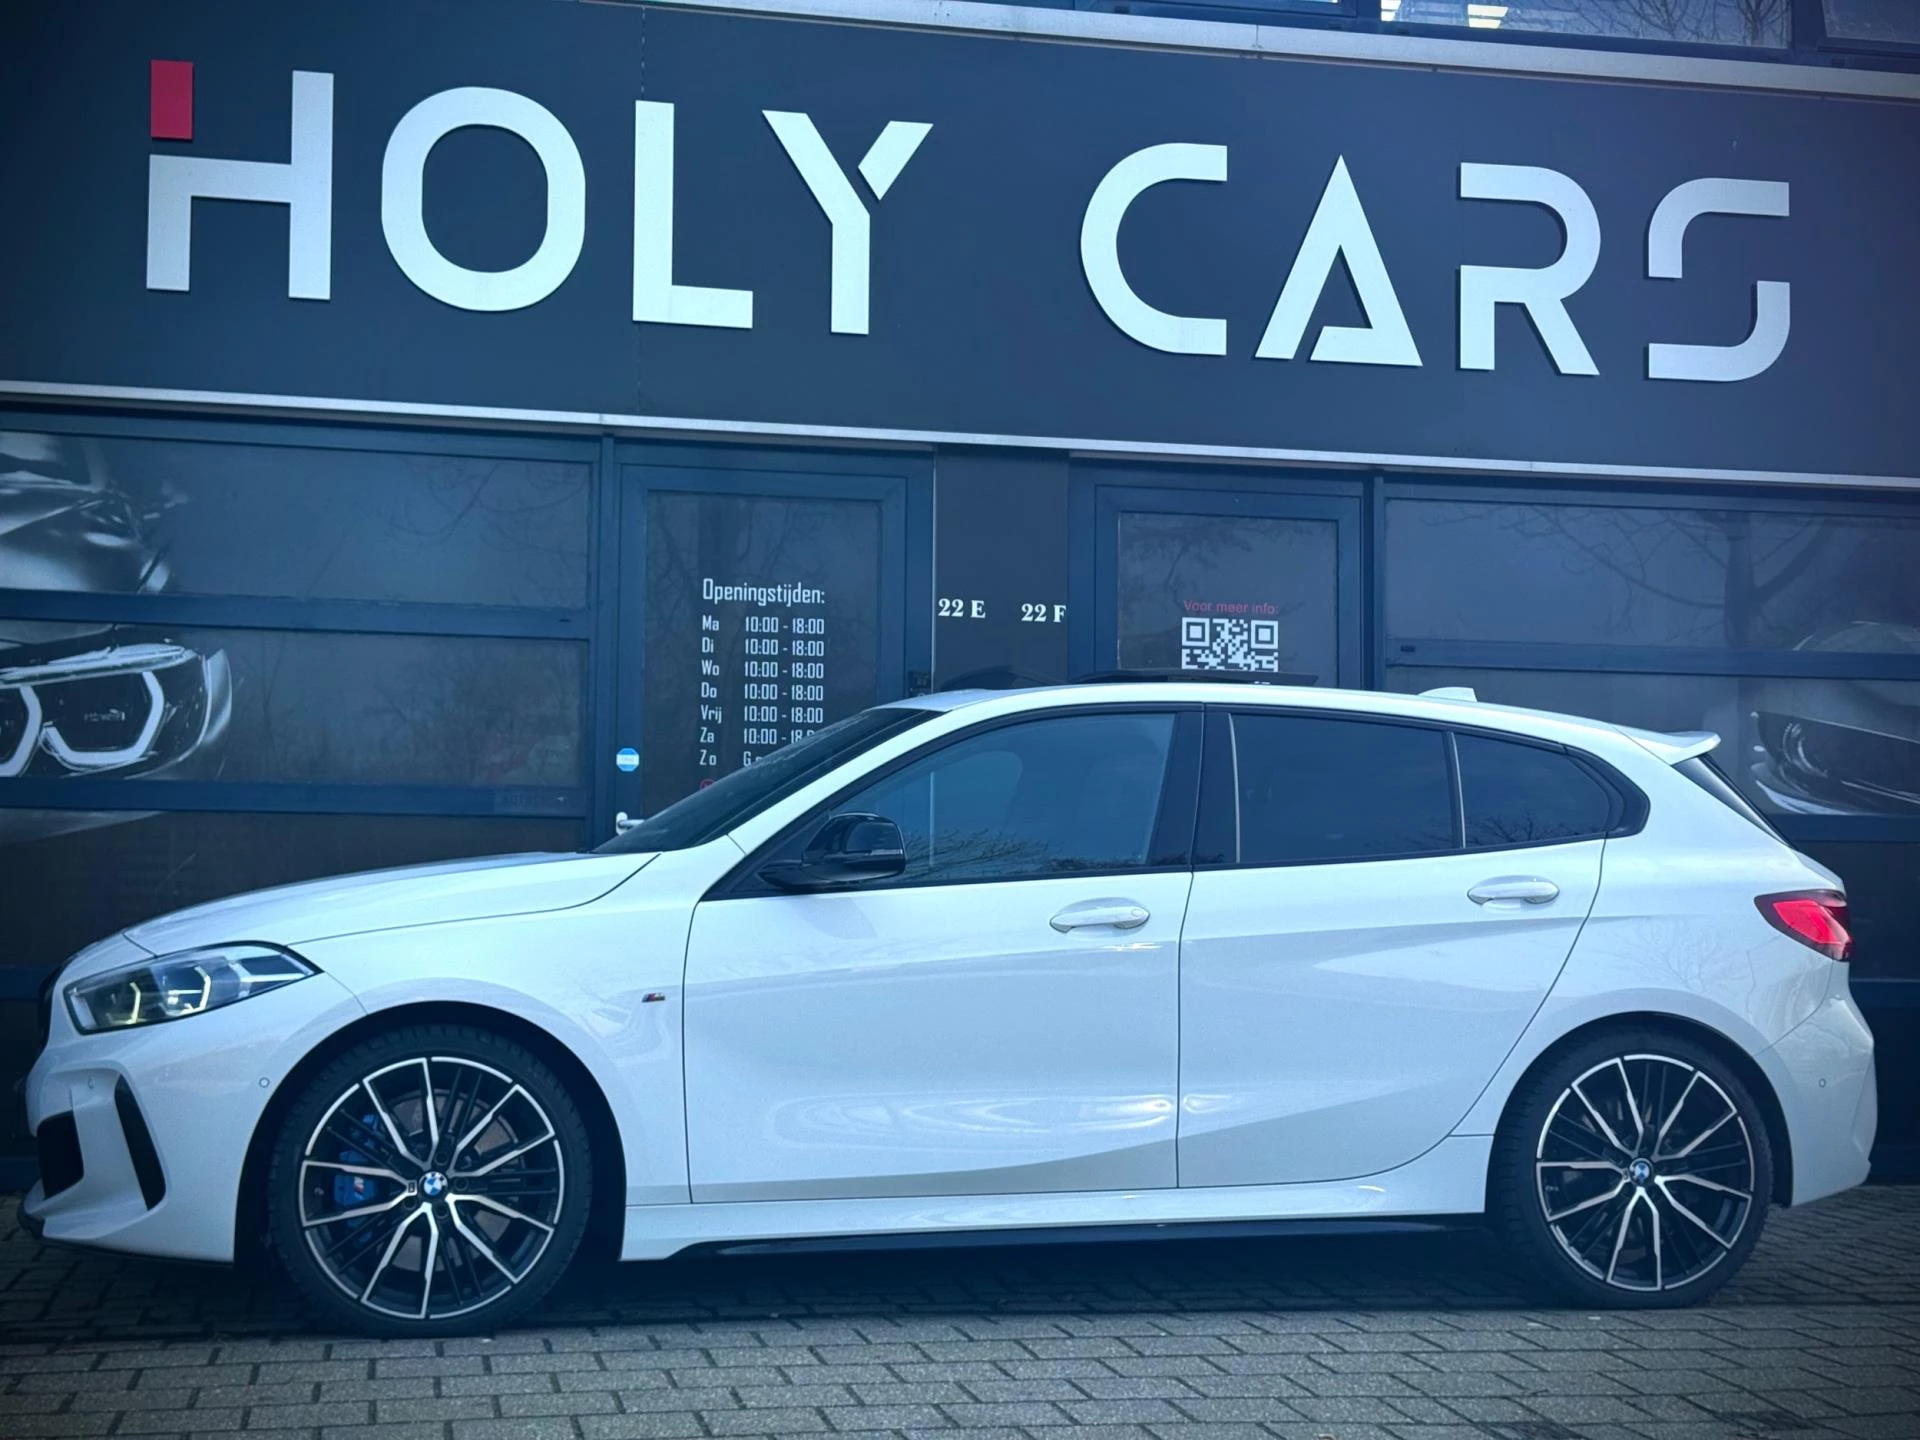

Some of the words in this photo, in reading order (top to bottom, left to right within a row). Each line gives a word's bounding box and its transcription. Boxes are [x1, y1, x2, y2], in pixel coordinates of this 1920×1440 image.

[146, 59, 934, 335] HOLY
[1080, 142, 1790, 382] CARS
[702, 578, 825, 607] Openingstijden:
[938, 598, 964, 617] 22
[971, 599, 986, 619] E
[1021, 603, 1047, 622] 22
[1053, 604, 1067, 623] F
[1183, 600, 1212, 613] Voor
[1216, 602, 1249, 614] meer
[702, 614, 720, 631] Ma
[745, 616, 779, 633] 10:00
[792, 618, 825, 635] 18:00
[701, 637, 714, 653] Di
[745, 638, 779, 655] 10:00
[792, 640, 825, 657] 18:00
[701, 659, 720, 676] Wo
[744, 661, 779, 678] 10:00
[791, 663, 824, 679] 18:00
[701, 681, 718, 698] Do
[744, 683, 778, 700] 10:00
[791, 685, 824, 701] 18:00
[700, 704, 722, 724] Vrij
[744, 705, 778, 723] 10:00
[791, 707, 824, 723] 18:00
[699, 726, 715, 743] Za
[743, 728, 778, 745] 10:00
[699, 749, 717, 766] Zo
